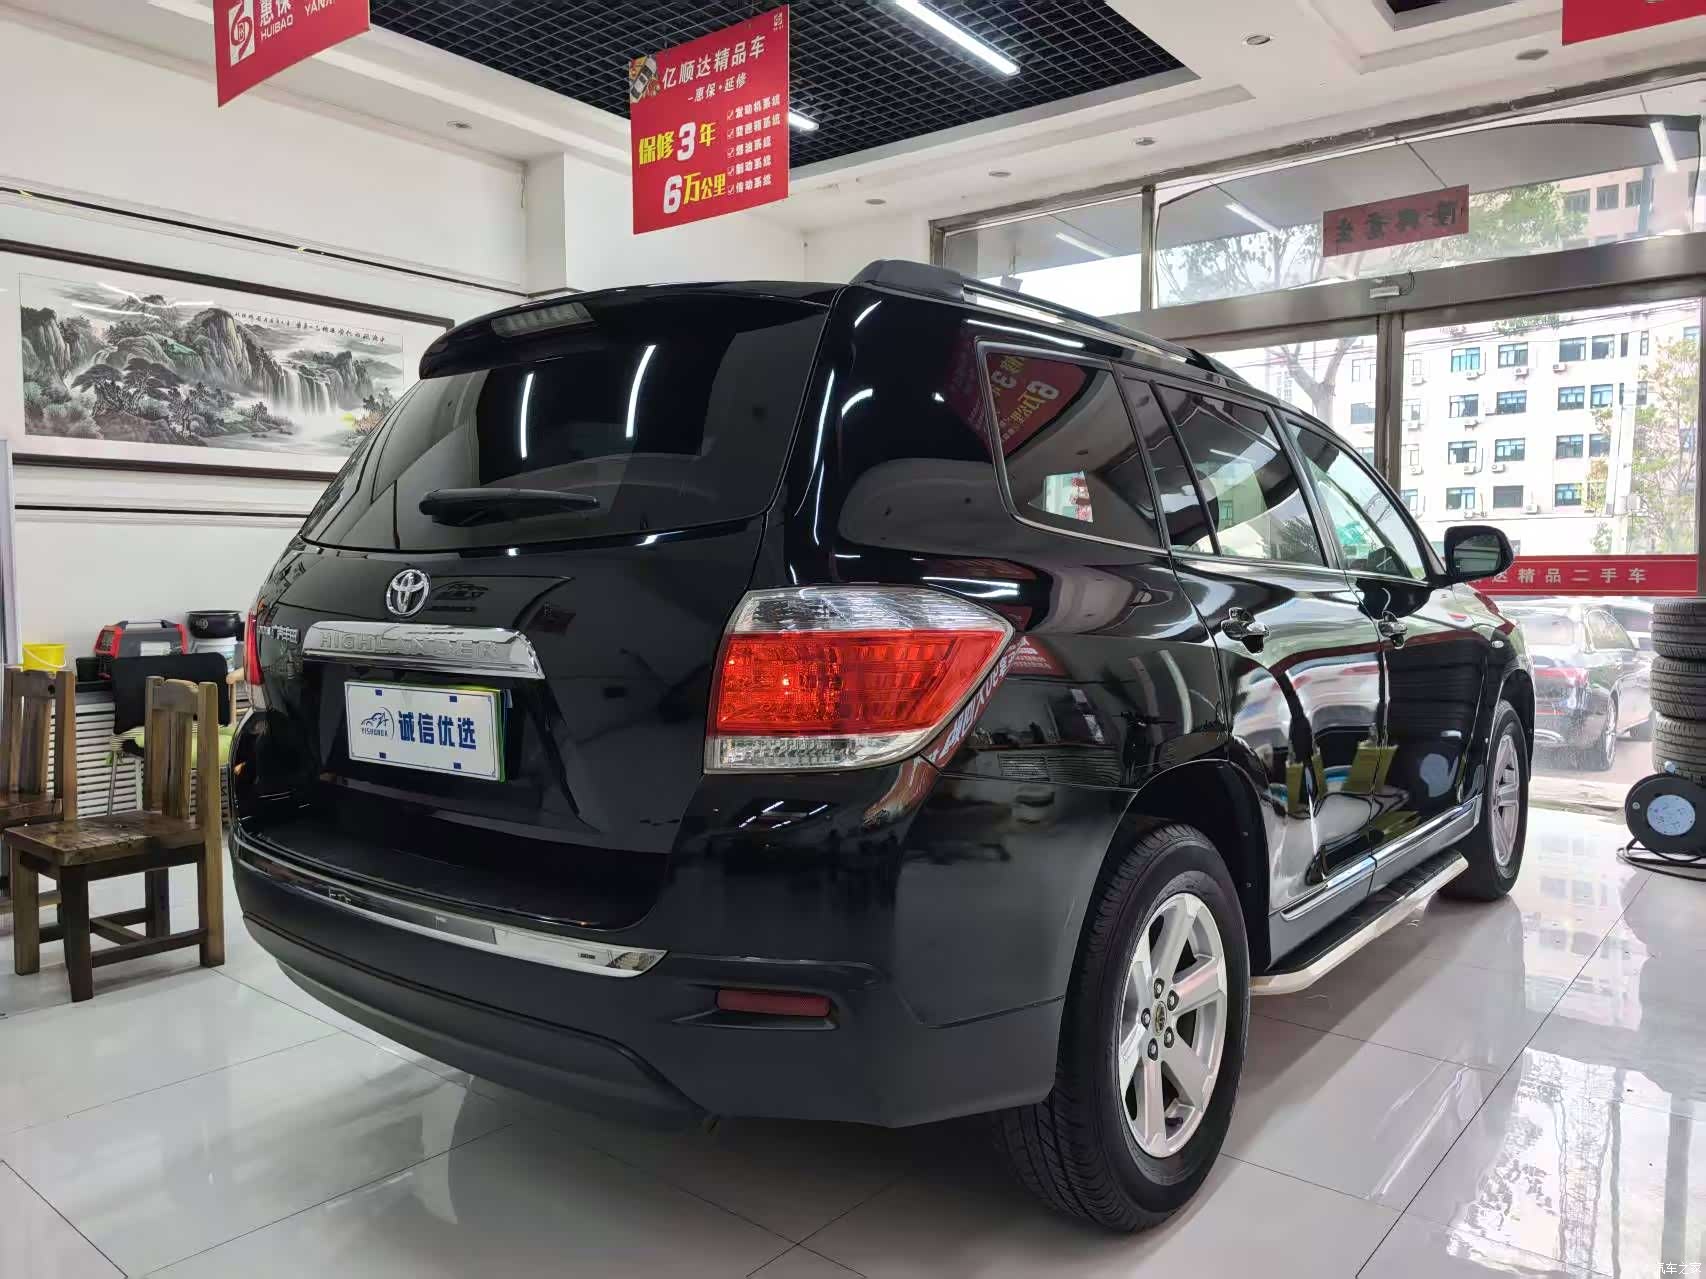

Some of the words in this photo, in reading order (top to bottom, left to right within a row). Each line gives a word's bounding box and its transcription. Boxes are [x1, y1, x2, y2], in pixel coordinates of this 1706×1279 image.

[260, 14, 294, 41] HUIBAO
[662, 34, 767, 90] 亿顺达精品车
[663, 172, 726, 214] 6万公里
[1474, 567, 1647, 584] 达精品二手车
[398, 710, 477, 750] 诚信优选
